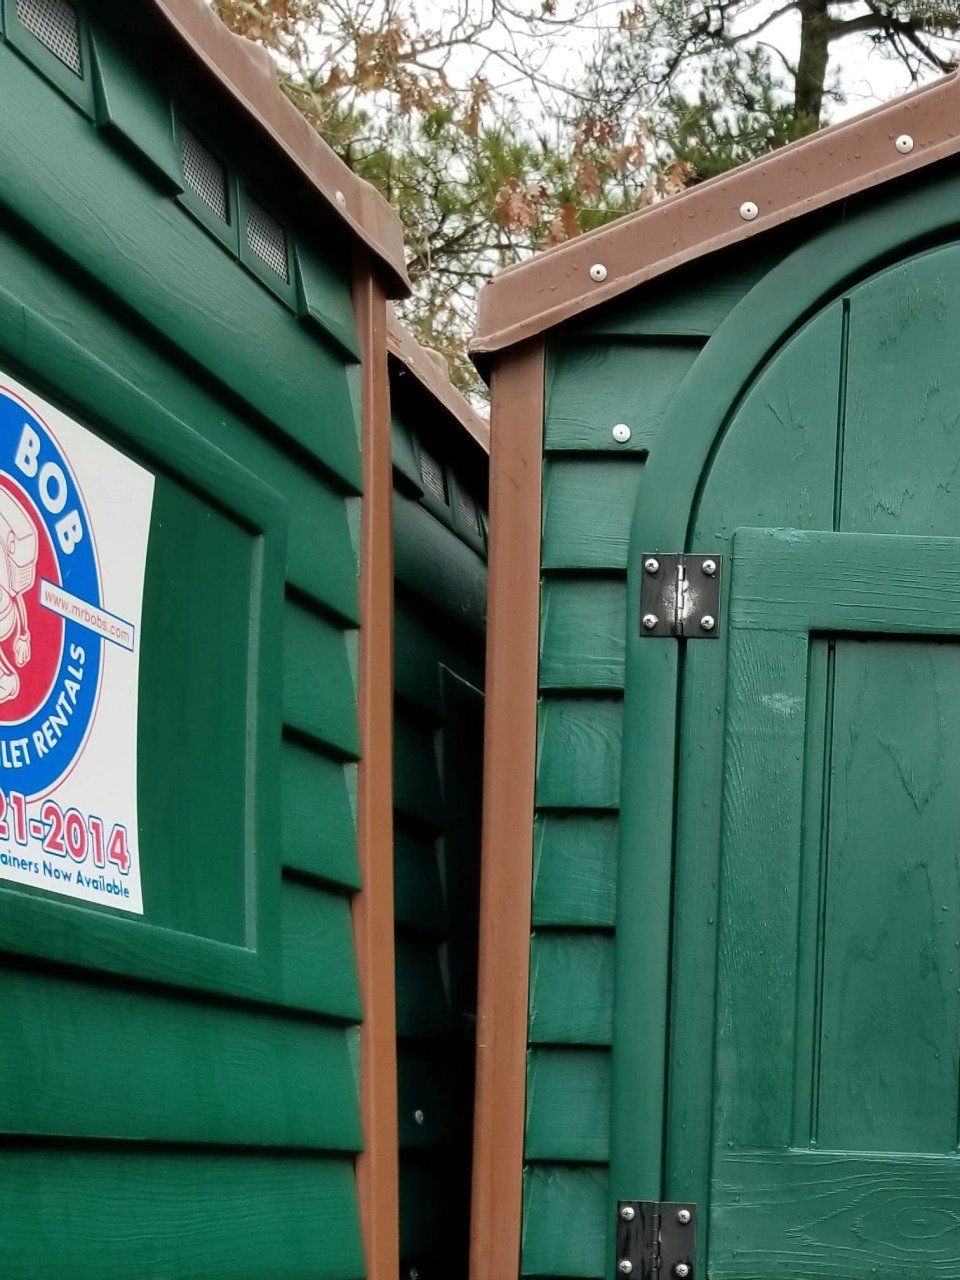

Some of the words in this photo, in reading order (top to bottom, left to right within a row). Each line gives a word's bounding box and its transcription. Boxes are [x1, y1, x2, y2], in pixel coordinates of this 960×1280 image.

[15, 423, 83, 554] BOB
[44, 589, 130, 645] www.mrbobs.com
[33, 643, 86, 758] RENTALS
[43, 860, 72, 882] Now
[76, 871, 130, 899] Available
